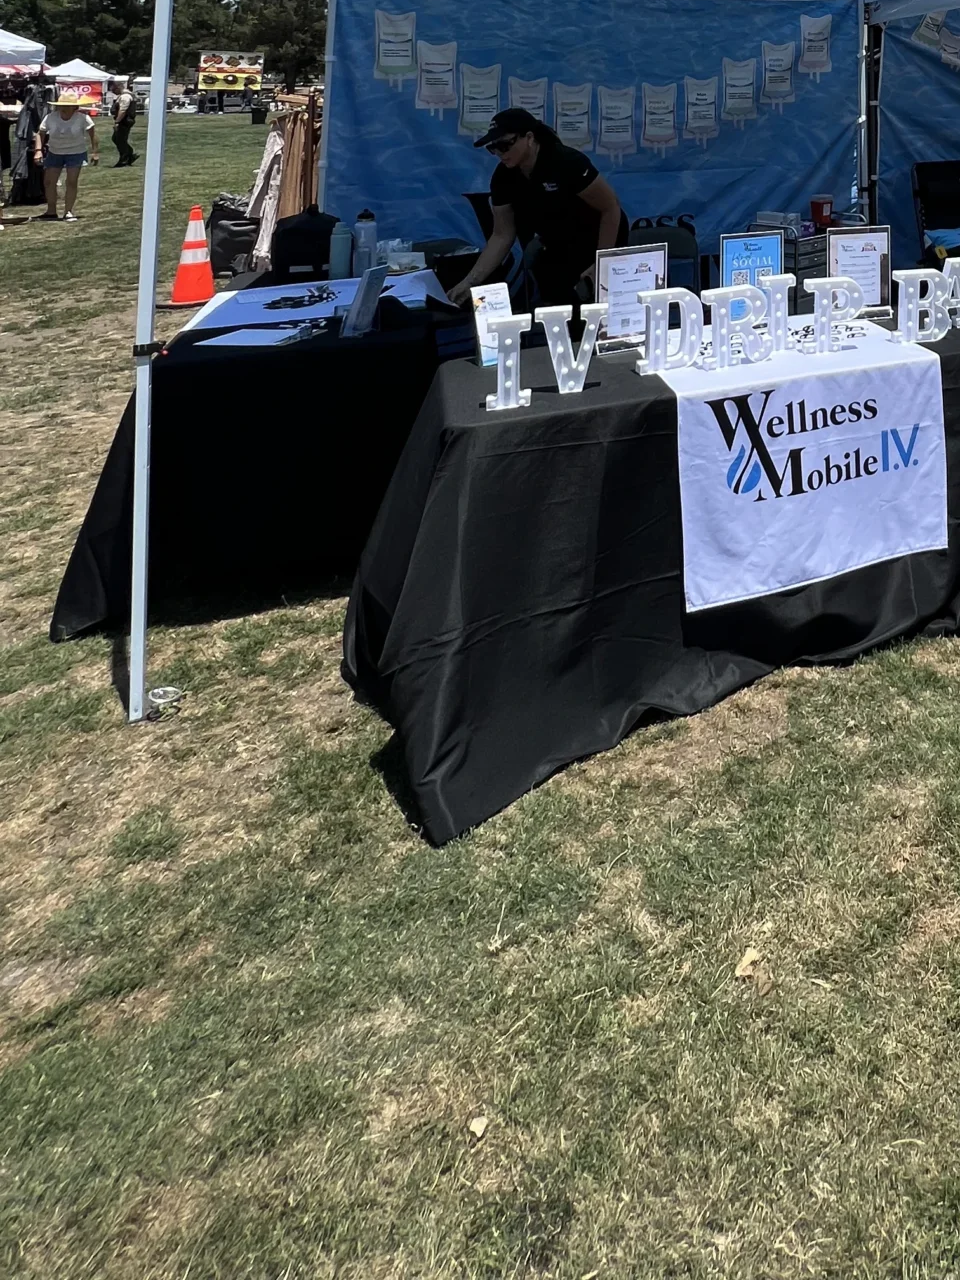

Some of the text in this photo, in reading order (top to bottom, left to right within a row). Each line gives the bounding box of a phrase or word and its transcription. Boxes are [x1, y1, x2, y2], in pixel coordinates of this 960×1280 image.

[733, 256, 774, 267] SOCIAL
[486, 303, 608, 411] IV
[635, 273, 865, 375] DRIP
[704, 389, 878, 451] Wellness
[753, 447, 878, 502] Mobile
